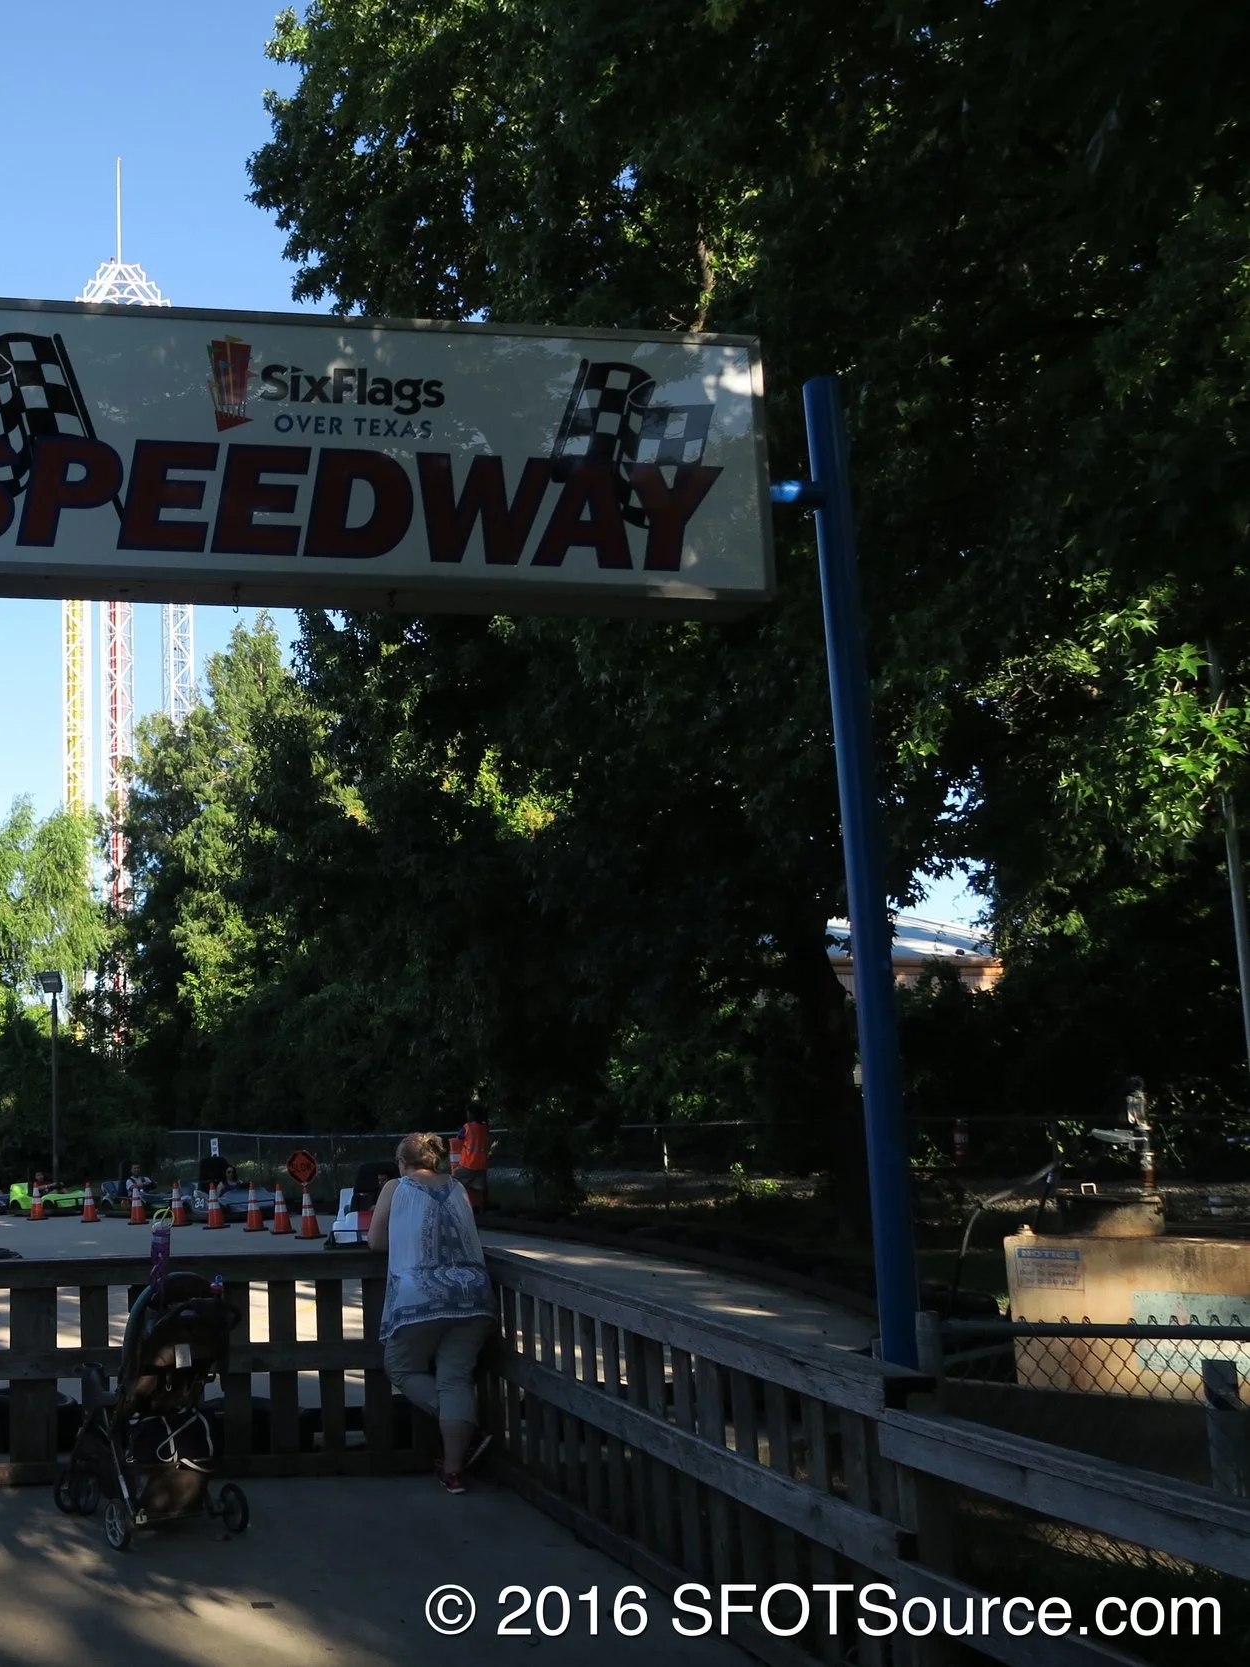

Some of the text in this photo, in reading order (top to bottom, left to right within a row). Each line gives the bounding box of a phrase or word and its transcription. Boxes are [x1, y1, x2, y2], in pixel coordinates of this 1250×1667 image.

[274, 414, 433, 439] OVER TEXAS
[194, 1197, 205, 1209] 34
[1021, 1249, 1076, 1259] NOTICE
